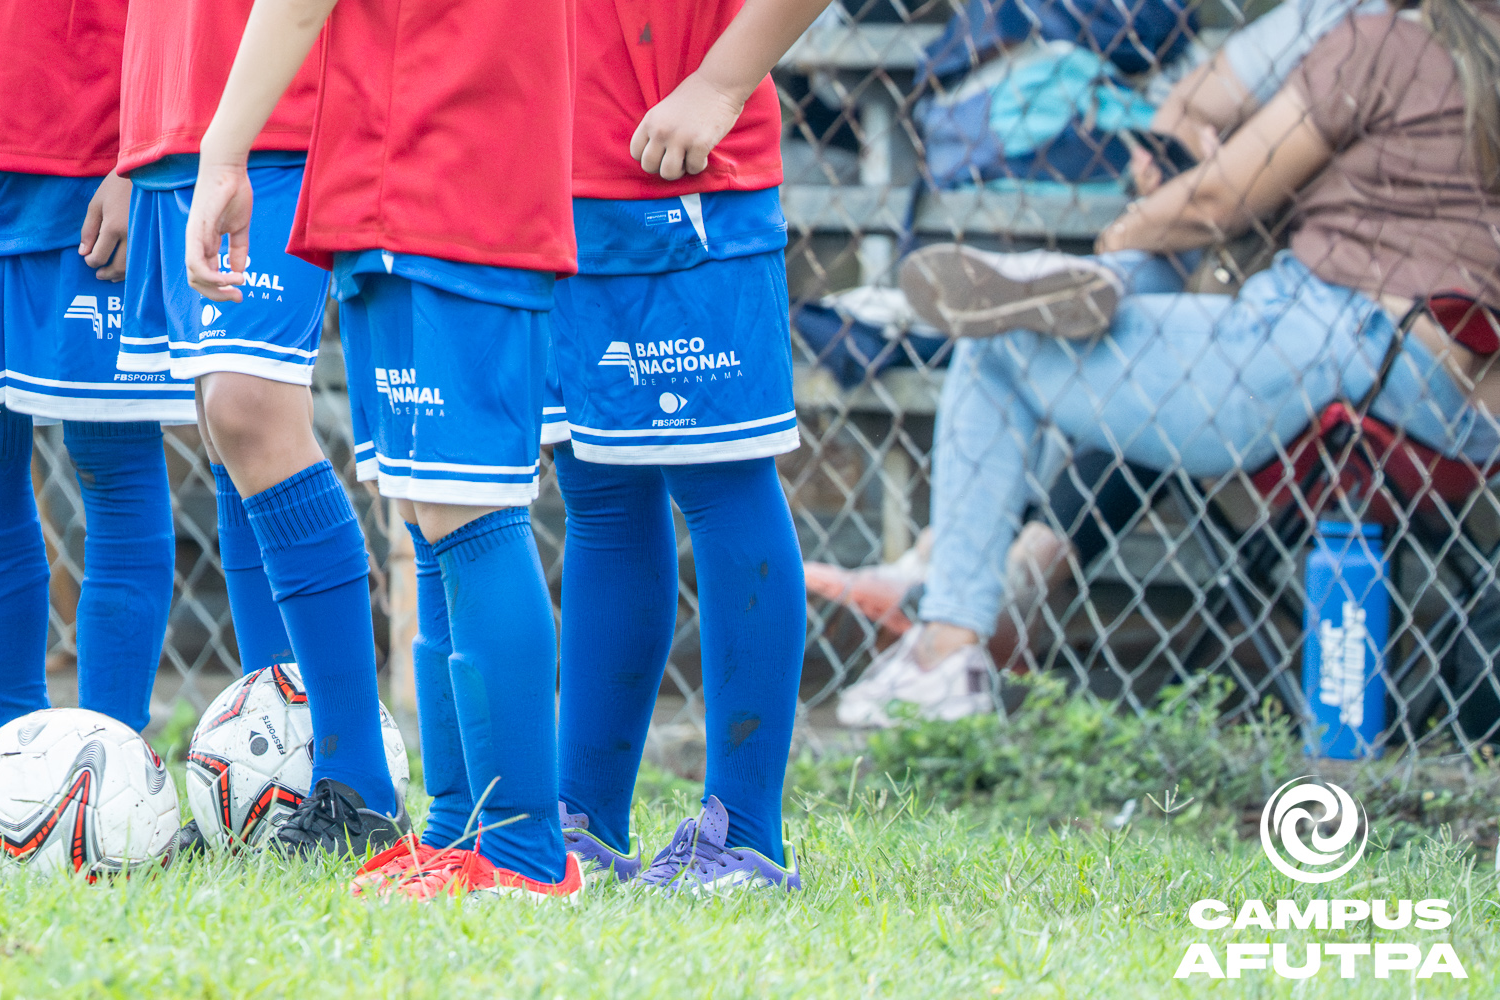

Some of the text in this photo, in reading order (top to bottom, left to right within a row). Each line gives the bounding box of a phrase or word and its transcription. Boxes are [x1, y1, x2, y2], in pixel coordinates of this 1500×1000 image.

[669, 212, 680, 220] 14
[635, 337, 705, 358] BANCO
[638, 350, 741, 375] NACIONAL
[113, 373, 166, 382] FBSPORTS
[642, 378, 657, 386] DE
[652, 418, 697, 427] FBSPORTS
[262, 715, 286, 755] FBSPORTS
